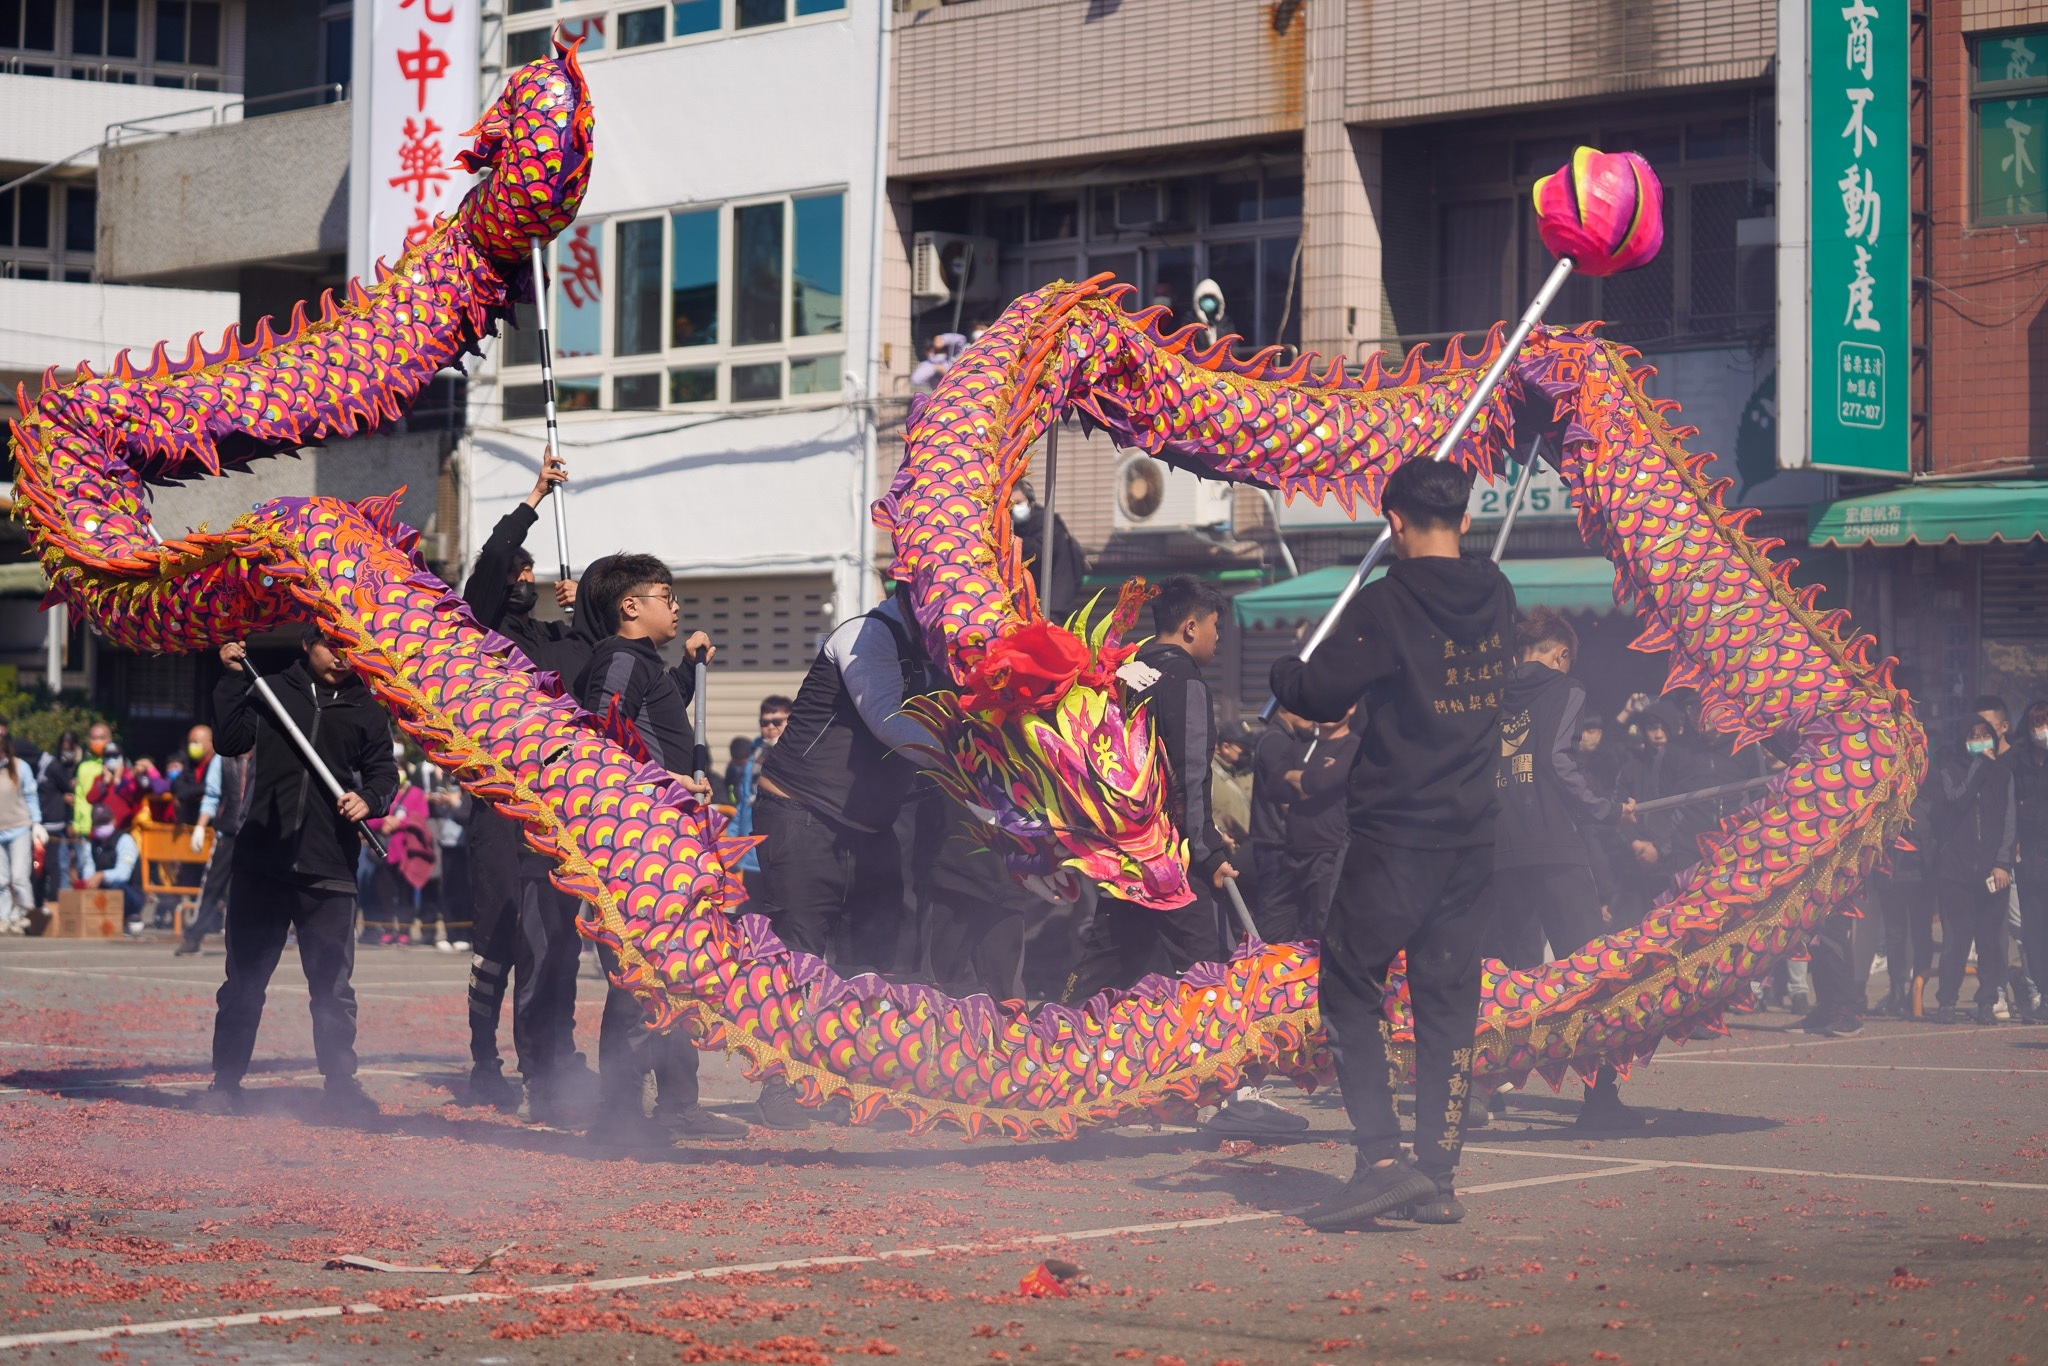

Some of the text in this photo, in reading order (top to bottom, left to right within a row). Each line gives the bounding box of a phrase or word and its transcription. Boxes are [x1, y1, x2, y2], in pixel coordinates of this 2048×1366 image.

[1838, 0, 1881, 332] 商不動產
[1847, 378, 1876, 399] 加盟店
[1842, 401, 1881, 420] 277-107
[1433, 688, 1504, 714] 阿帕契遊
[1514, 772, 1533, 784] YUE
[1437, 1047, 1471, 1151] 躍動苗栗
